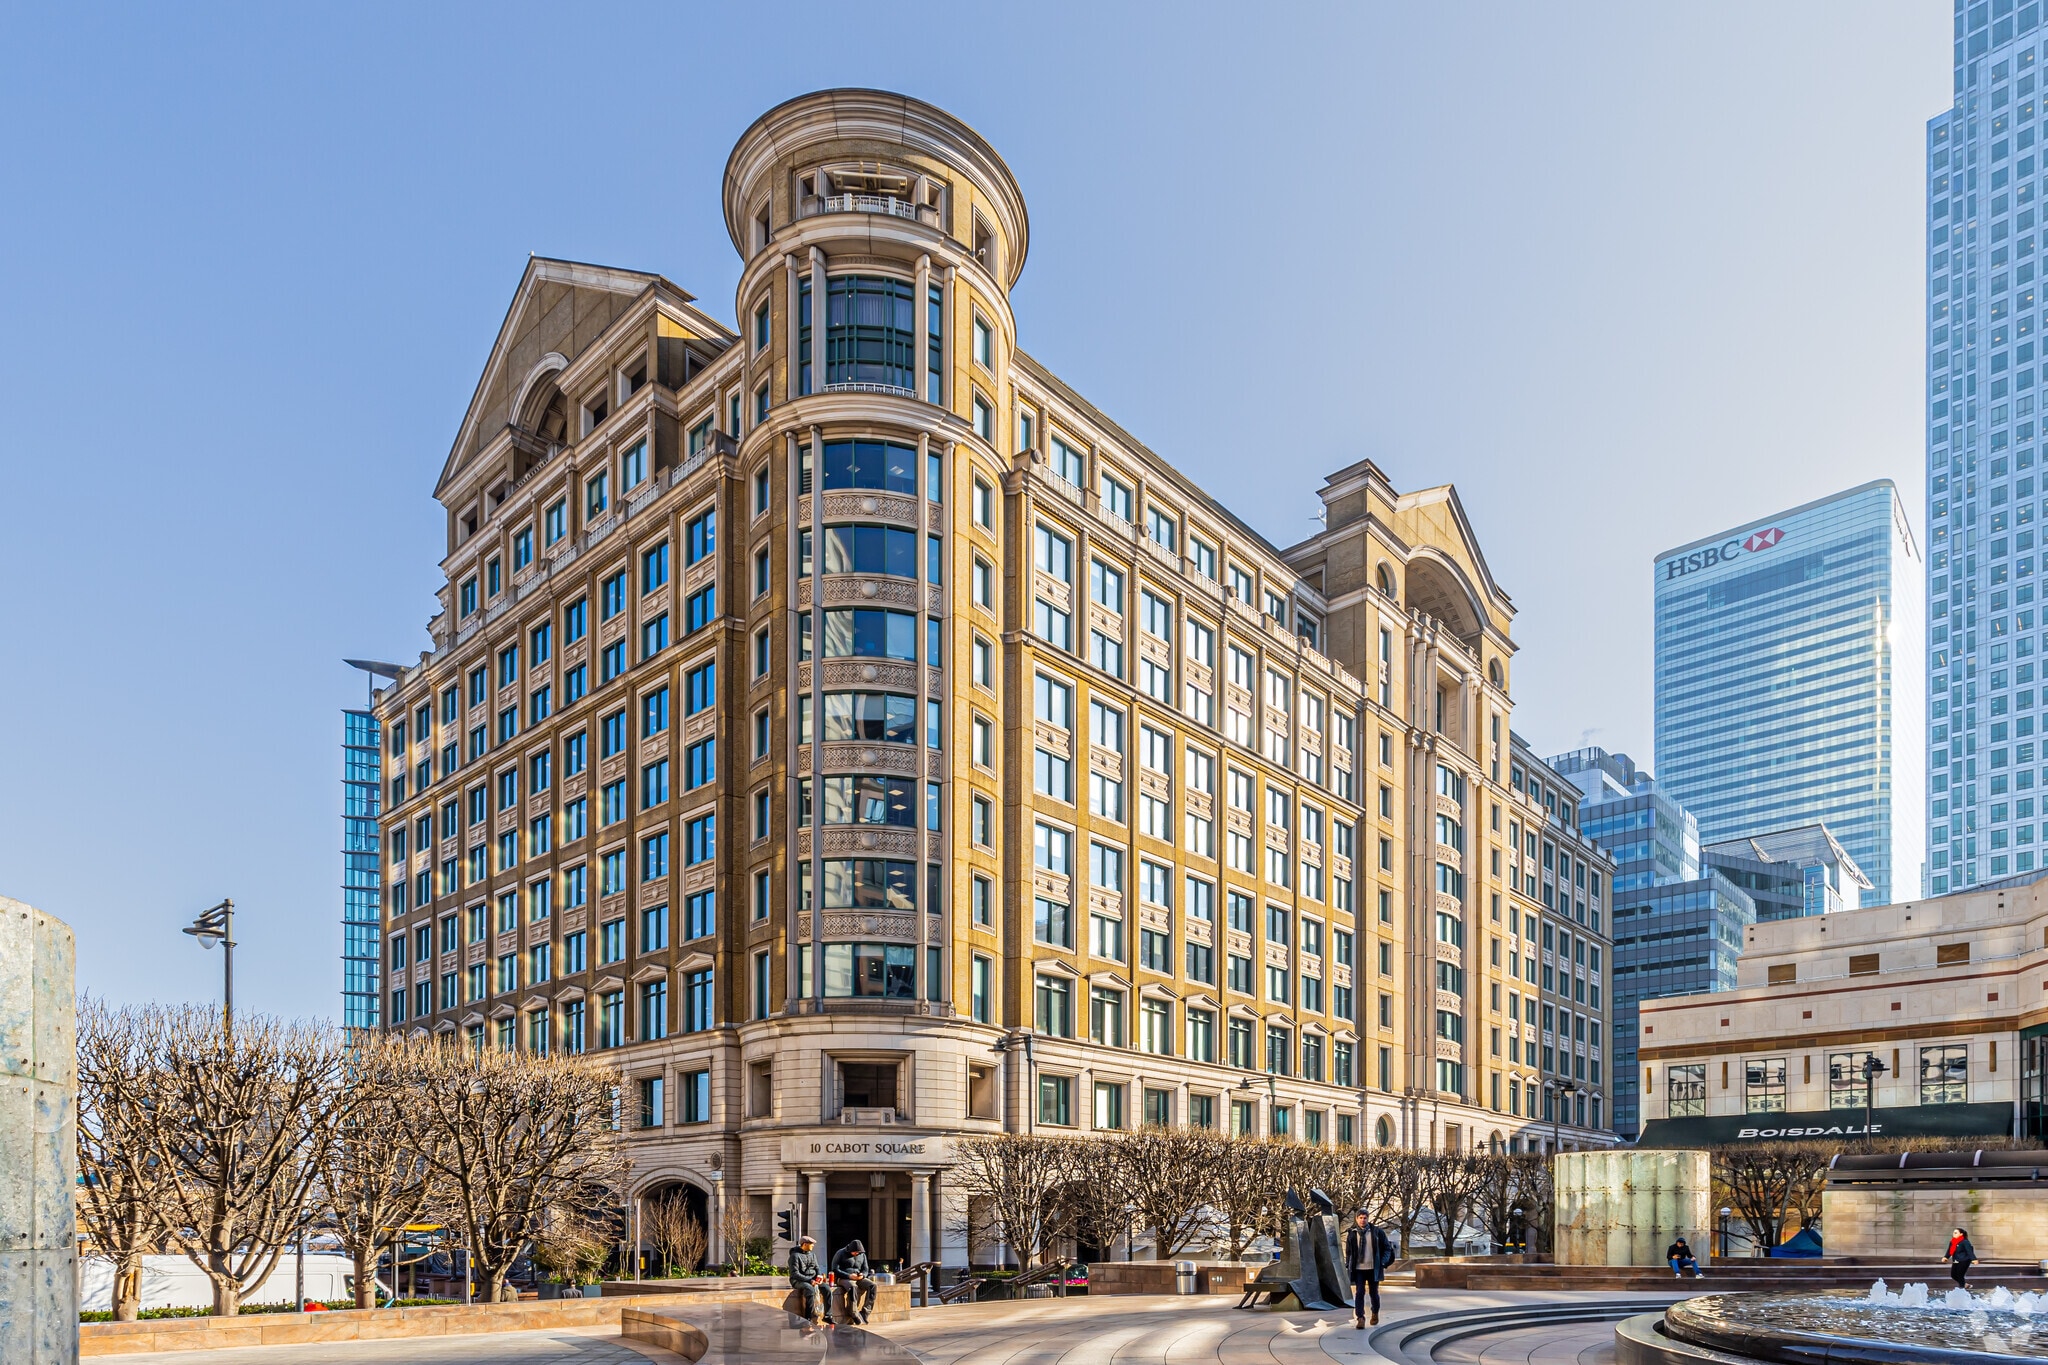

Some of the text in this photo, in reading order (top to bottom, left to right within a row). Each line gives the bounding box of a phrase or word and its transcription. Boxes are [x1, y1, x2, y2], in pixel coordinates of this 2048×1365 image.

[1666, 539, 1740, 580] HSBC
[1737, 1124, 1882, 1139] BOISDALE
[810, 1143, 926, 1155] 10 CABOT SQUARE
